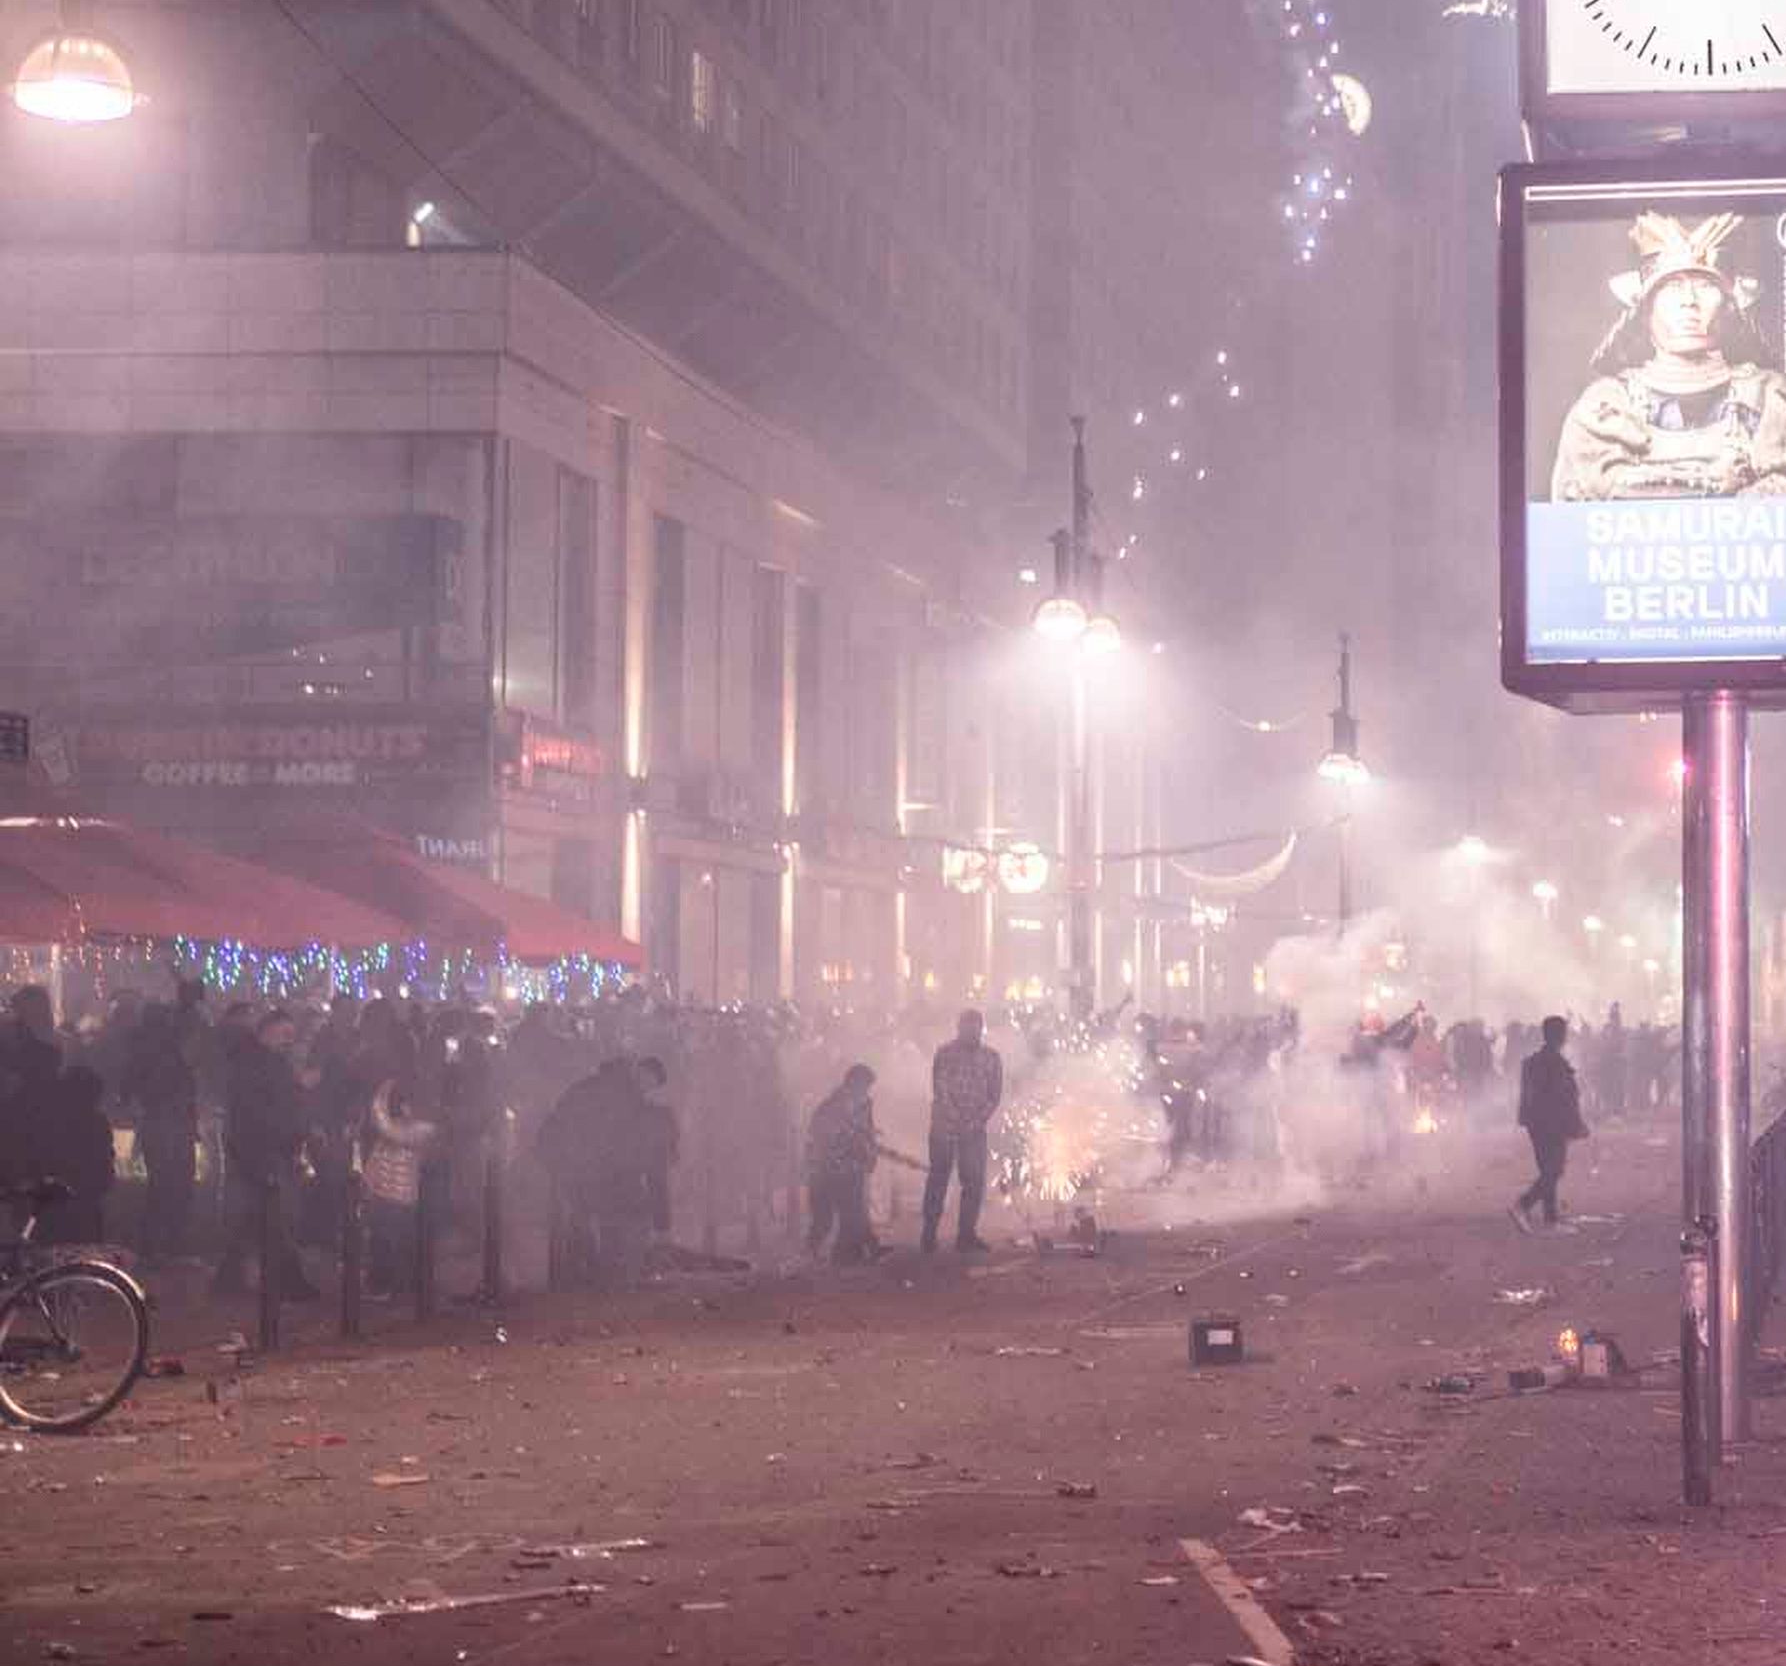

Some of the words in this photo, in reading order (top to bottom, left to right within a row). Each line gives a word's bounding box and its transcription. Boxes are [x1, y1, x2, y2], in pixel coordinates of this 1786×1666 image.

[1586, 504, 1786, 544] SAMURAI
[1587, 543, 1786, 583] MUSEUM
[1604, 583, 1769, 622] BERLIN
[274, 760, 355, 786] MORE
